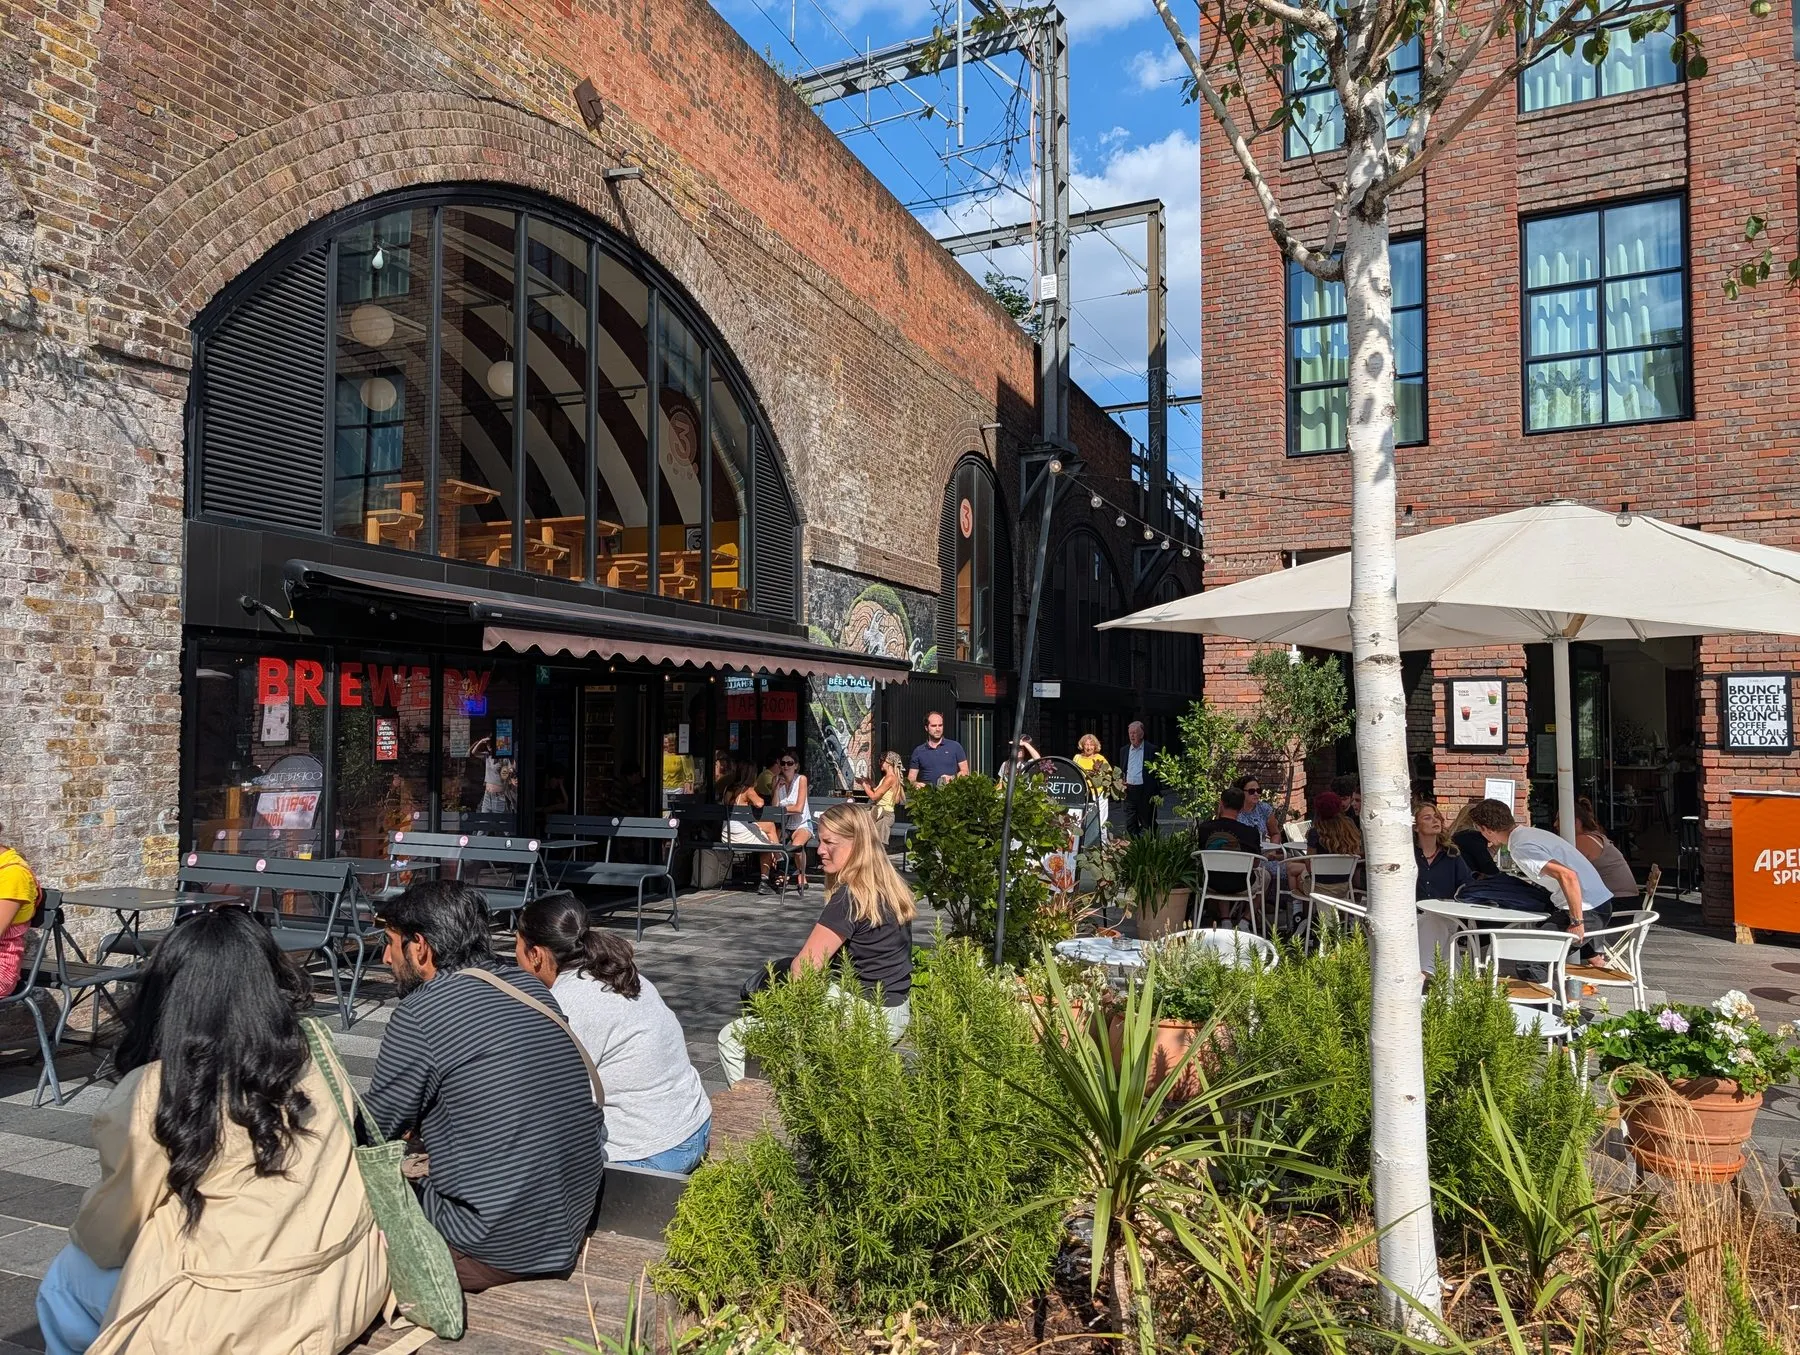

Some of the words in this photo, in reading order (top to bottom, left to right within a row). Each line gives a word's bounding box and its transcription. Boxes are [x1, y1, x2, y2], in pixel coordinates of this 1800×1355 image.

[962, 504, 970, 533] 3
[258, 657, 491, 709] BREWERY
[828, 677, 848, 687] BEER
[850, 679, 872, 688] HALL
[1729, 684, 1786, 695] BRUNCH
[1729, 694, 1779, 704] COFFEE
[1729, 704, 1787, 713] COCKTAILS
[1730, 712, 1787, 721] BRUNCH
[1730, 721, 1767, 729] COFFEE
[1730, 728, 1788, 736] COCKTAILS
[1730, 736, 1754, 746] ALL
[1759, 736, 1787, 746] DAY
[1753, 848, 1800, 872] APE
[1773, 868, 1800, 885] SPR
